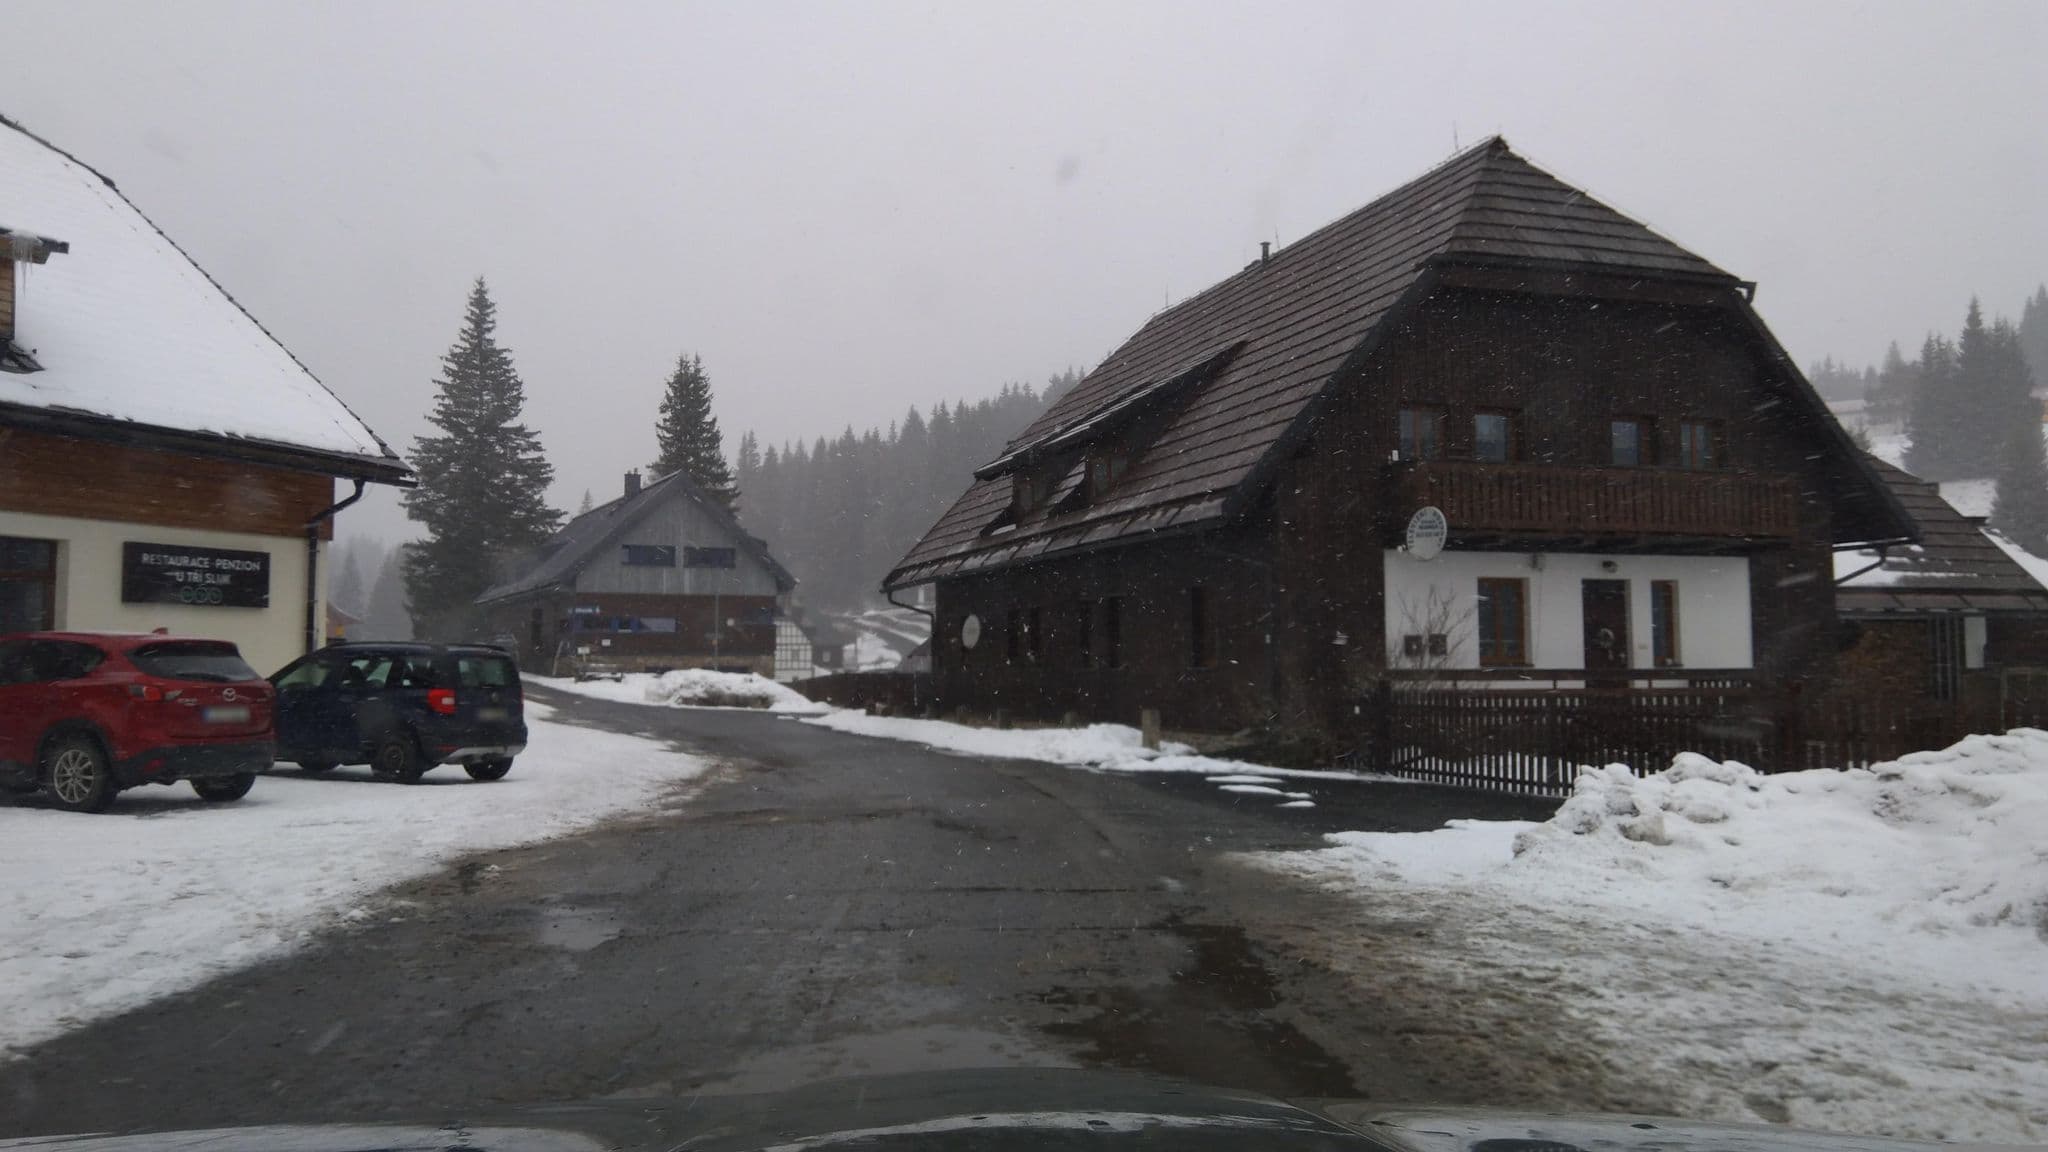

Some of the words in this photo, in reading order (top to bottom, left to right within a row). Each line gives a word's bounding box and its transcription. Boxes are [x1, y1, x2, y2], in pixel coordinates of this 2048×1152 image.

[141, 553, 210, 568] RESTAURACE
[215, 558, 260, 571] PENZION
[176, 571, 185, 582] U
